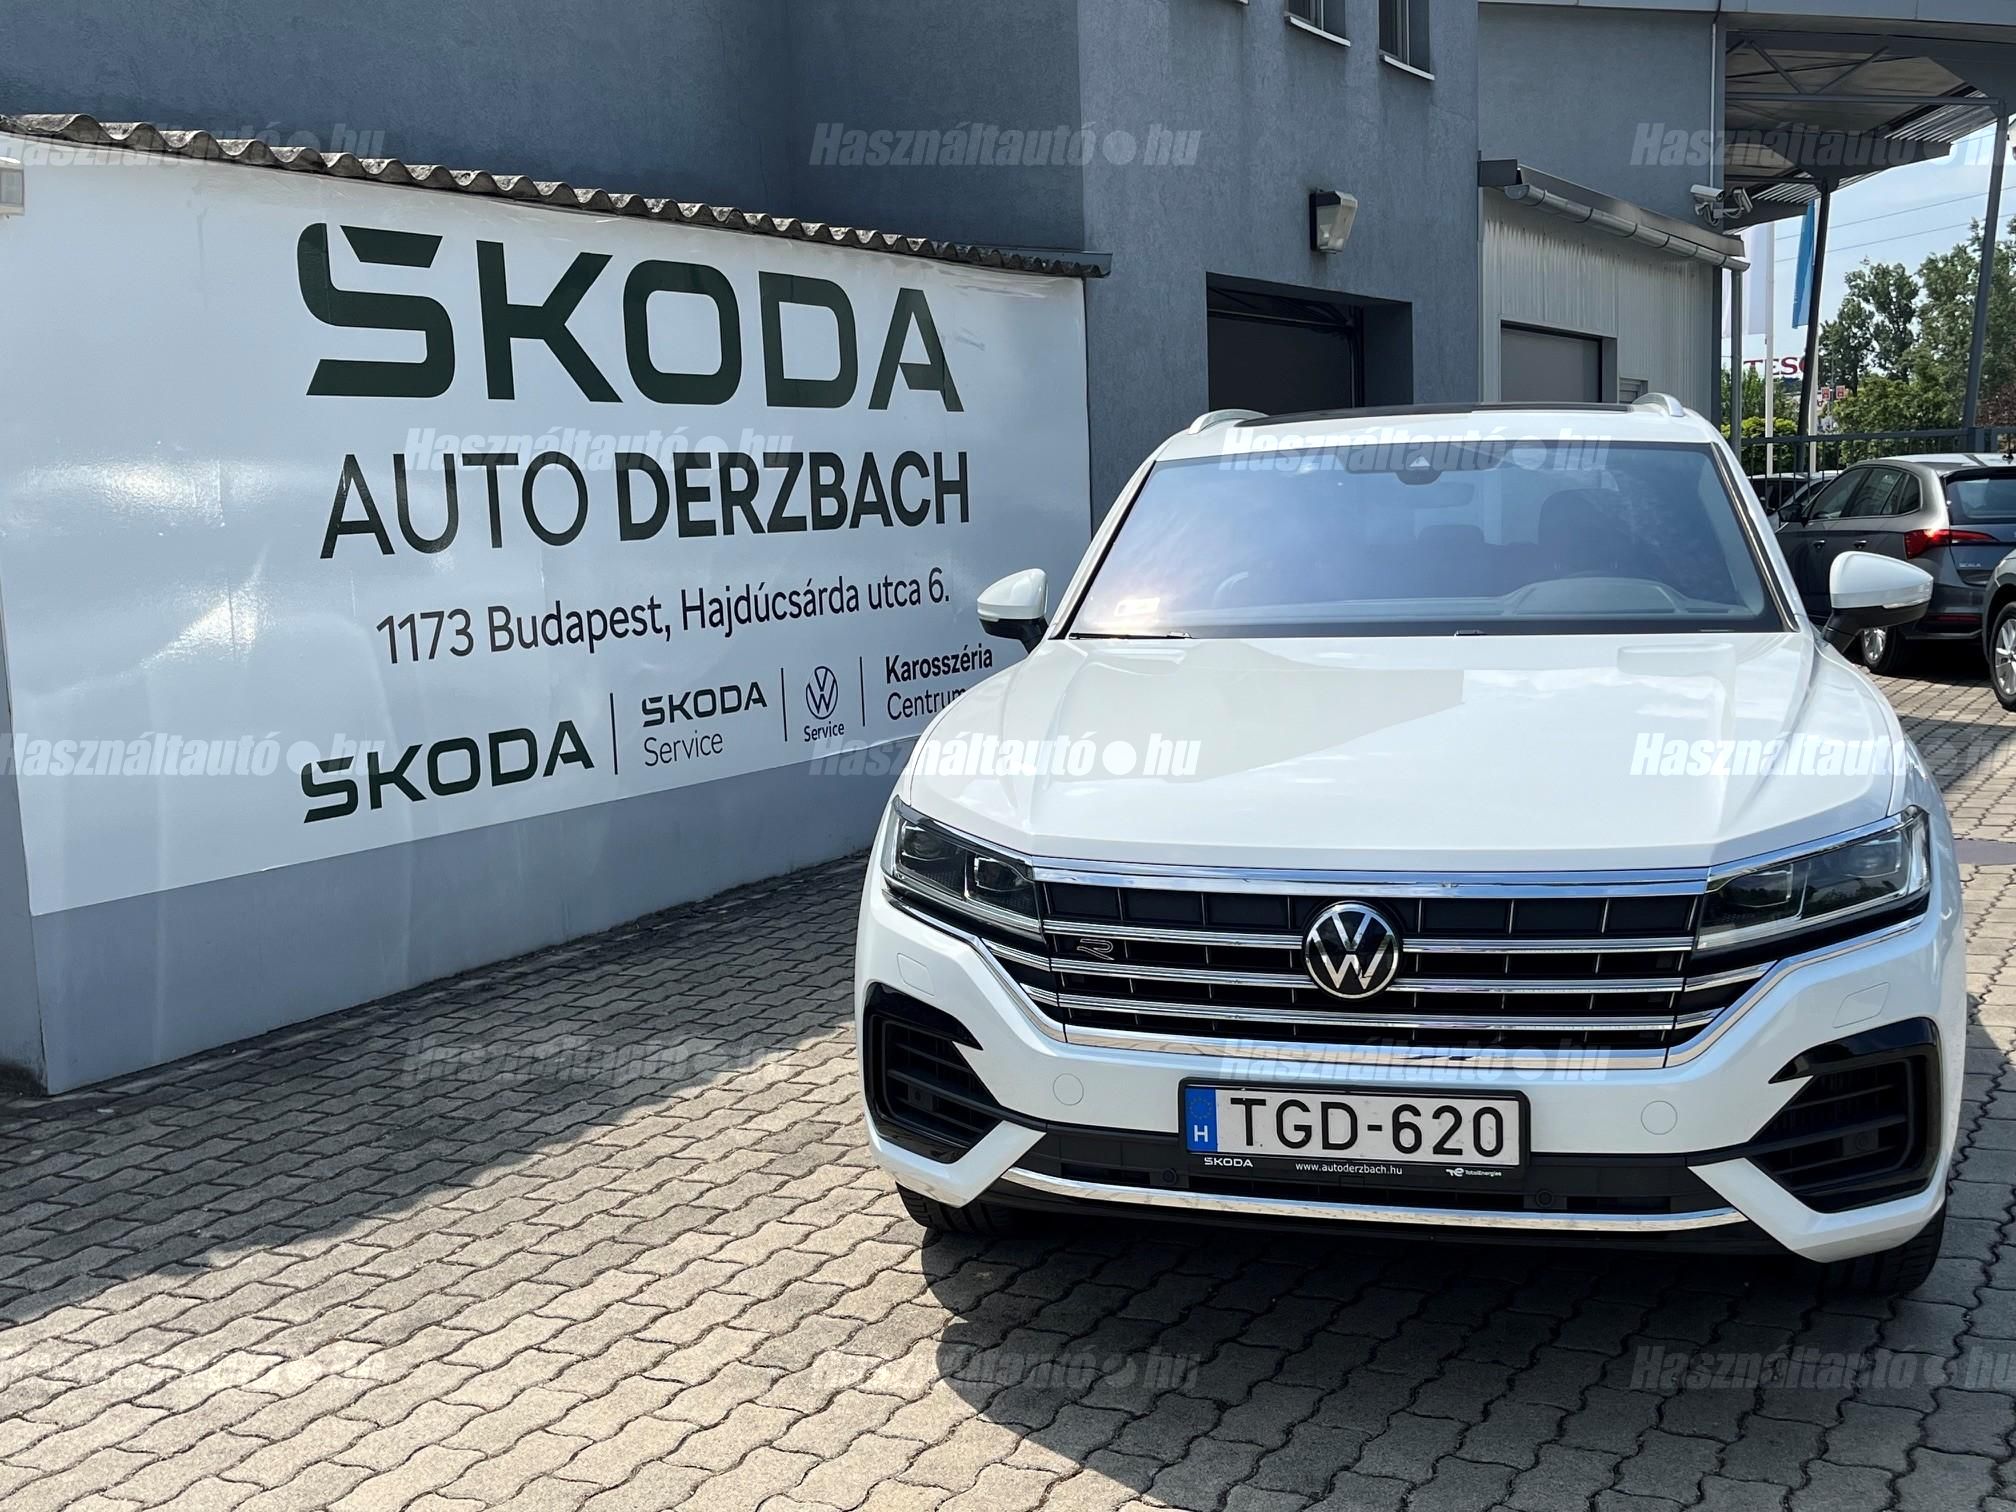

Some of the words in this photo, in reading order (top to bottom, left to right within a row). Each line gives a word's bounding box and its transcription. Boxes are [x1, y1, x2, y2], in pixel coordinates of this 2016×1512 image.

[320, 450, 588, 559] AUTO
[614, 450, 970, 542] DERZBACH
[376, 608, 474, 664] 1173
[487, 595, 671, 654] Budapest,
[681, 576, 860, 638] Hajdúcsárda
[868, 574, 921, 611] utca
[928, 566, 951, 604] 6.
[885, 643, 993, 684] Karosszéria
[643, 729, 724, 768] Service
[804, 720, 845, 742] Service
[1194, 1125, 1209, 1143] H
[1230, 1097, 1504, 1158] TGD-620
[1295, 1162, 1403, 1175] www.autoderzbach.hu
